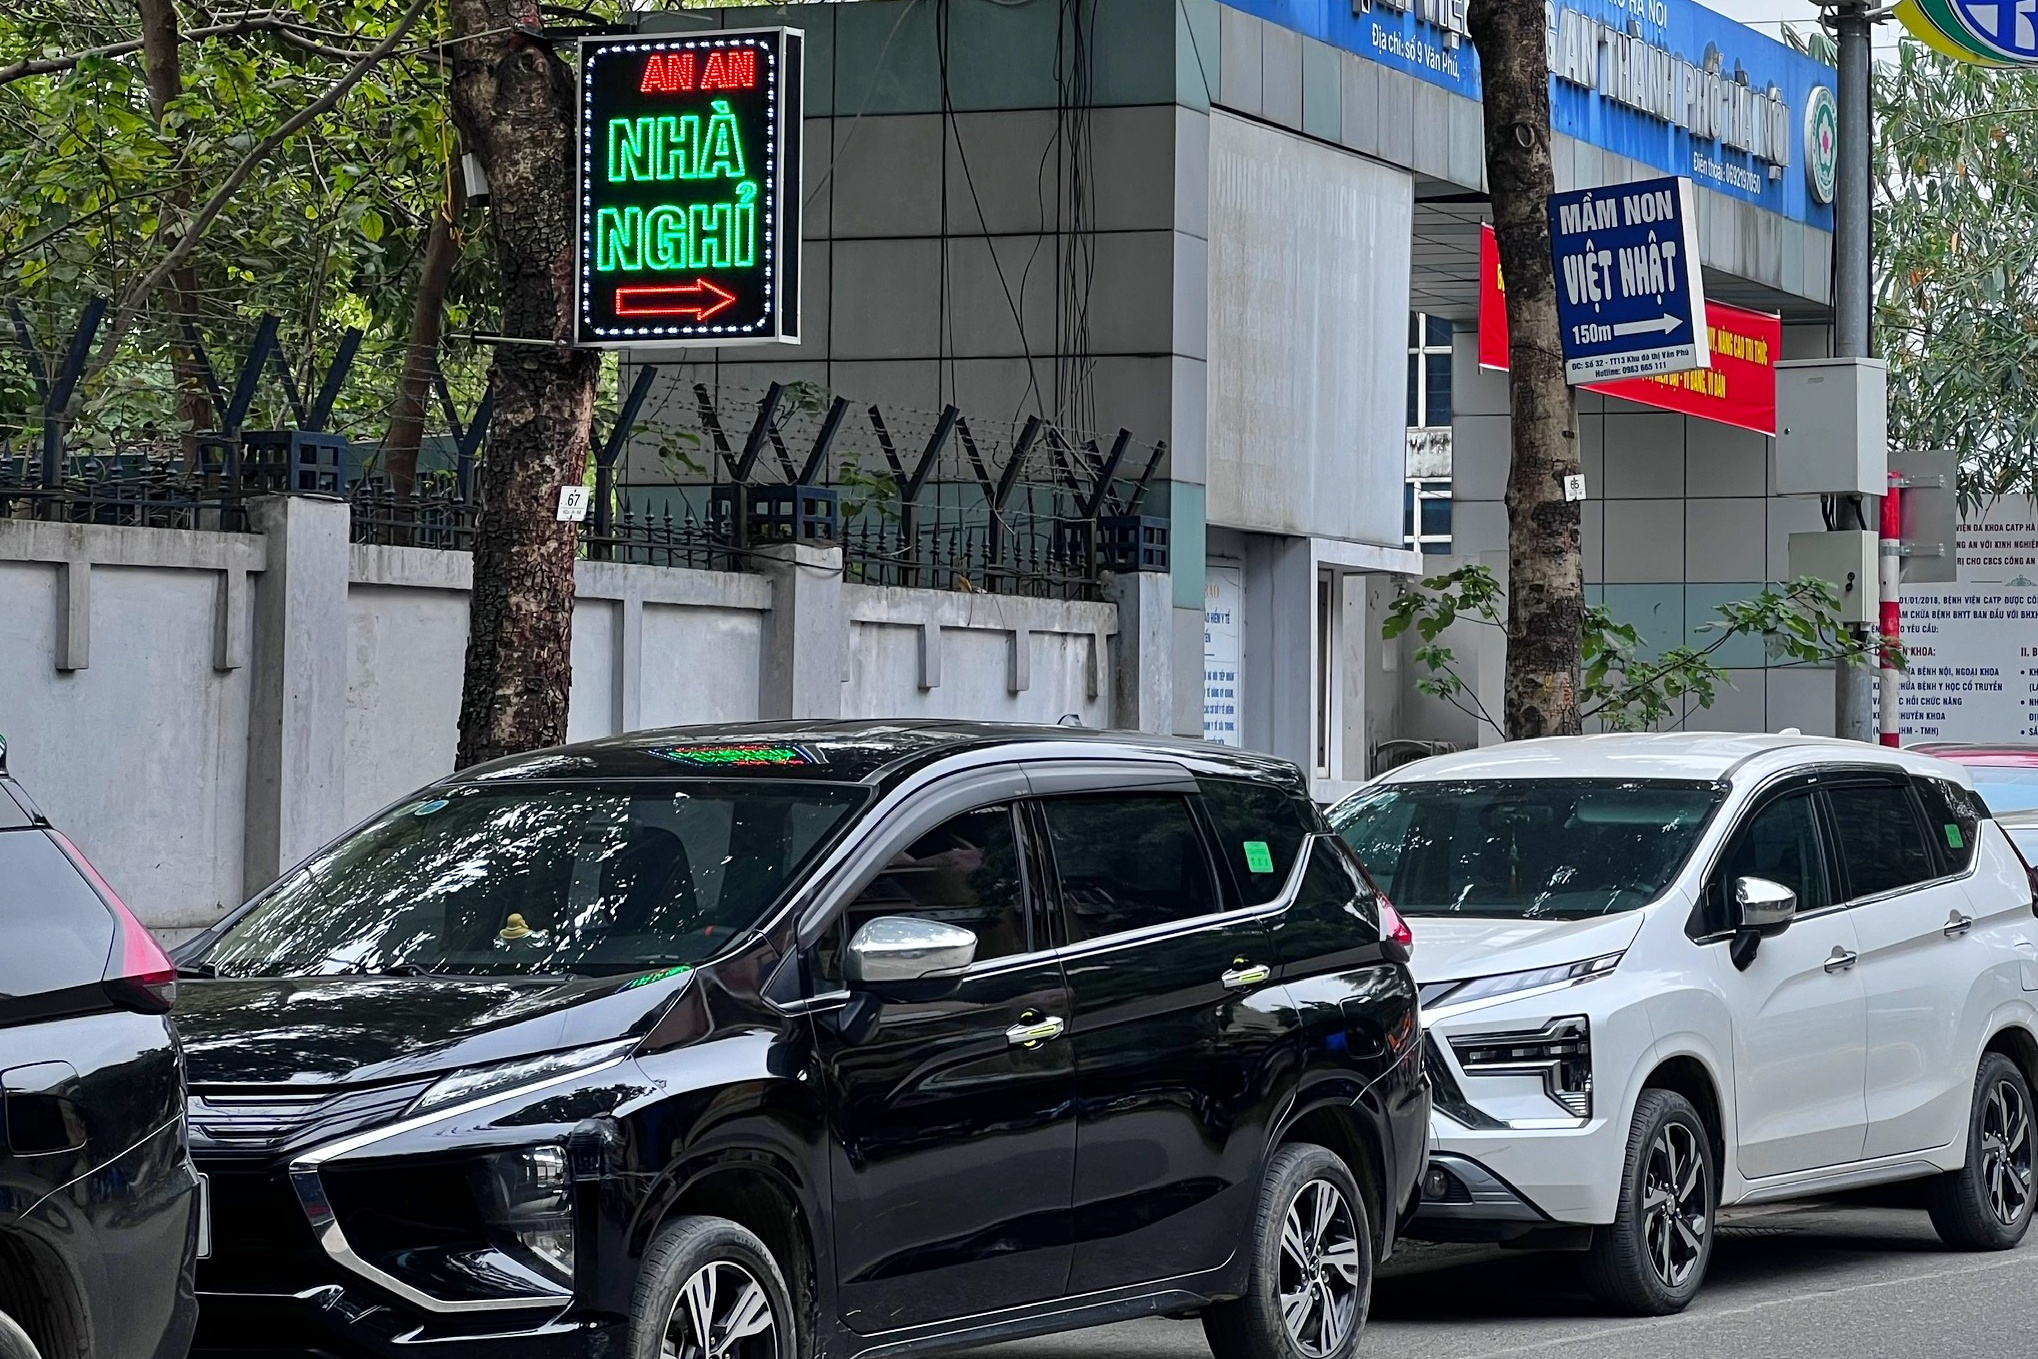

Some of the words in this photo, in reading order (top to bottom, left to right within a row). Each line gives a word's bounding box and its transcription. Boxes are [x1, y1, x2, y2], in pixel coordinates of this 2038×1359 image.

[1648, 0, 1668, 34] NỘI
[1372, 22, 1387, 55] Địa
[1405, 35, 1416, 61] số
[1417, 41, 1423, 64] 9
[640, 53, 694, 92] AN
[700, 51, 754, 90] AN
[1599, 20, 1677, 124] THÀNH
[1677, 52, 1722, 141] PHỐ
[1721, 69, 1754, 155] HÀ
[1753, 86, 1791, 181] NỘI
[608, 100, 745, 182] NHÀ
[1559, 192, 1619, 235] MẦM
[1623, 190, 1674, 226] NON
[596, 181, 757, 272] NGHỈ
[1562, 238, 1613, 313] VIỆT
[1619, 230, 1676, 305] NHẬT
[1572, 323, 1612, 345] 150m
[1595, 359, 1604, 367] 32
[1595, 369, 1621, 378] Hotline:
[1655, 361, 1667, 369] 111
[567, 493, 581, 507] 67
[1984, 523, 2004, 532] KHOA
[2005, 523, 2024, 532] CATP
[2025, 521, 2036, 532] HÀ
[1968, 540, 1978, 549] AN
[1980, 539, 1993, 549] VỚI
[1994, 540, 2012, 549] KINH
[2013, 539, 2038, 550] NGHIỆ
[1956, 557, 1965, 567] RỊ
[1966, 557, 1981, 566] CHO
[1983, 557, 2003, 566] CBCS
[2004, 555, 2024, 566] CÔNG
[2025, 557, 2036, 566] AN
[1943, 595, 1962, 605] BỆNH
[1964, 595, 1981, 605] VIỆN
[1983, 597, 2002, 605] CATP
[2004, 595, 2024, 606] ĐƯỢC
[2026, 594, 2038, 605] CÔ
[1910, 609, 1930, 619] CHỮA
[1932, 609, 1951, 620] BỆNH
[1952, 610, 1971, 619] BHYT
[1973, 610, 1987, 619] BAN
[1907, 624, 1921, 634] YÊU
[1910, 646, 1936, 657] KHOA:
[1917, 666, 1937, 676] BỆNH
[1938, 666, 1954, 677] NỘI,
[1955, 667, 1978, 678] NGOẠI
[1979, 667, 2000, 676] KHOA
[1900, 681, 1915, 691] HỮA
[1917, 681, 1937, 692] BỆNH
[1938, 682, 1944, 691] Y
[1945, 682, 1961, 692] HỌC
[1920, 695, 1941, 706] CHỨC
[1942, 696, 1963, 706] NĂNG
[1900, 711, 1924, 721] HUYÊN
[1926, 712, 1946, 720] KHOA
[1899, 727, 1913, 735] HM
[1920, 727, 1939, 737] TMH)
